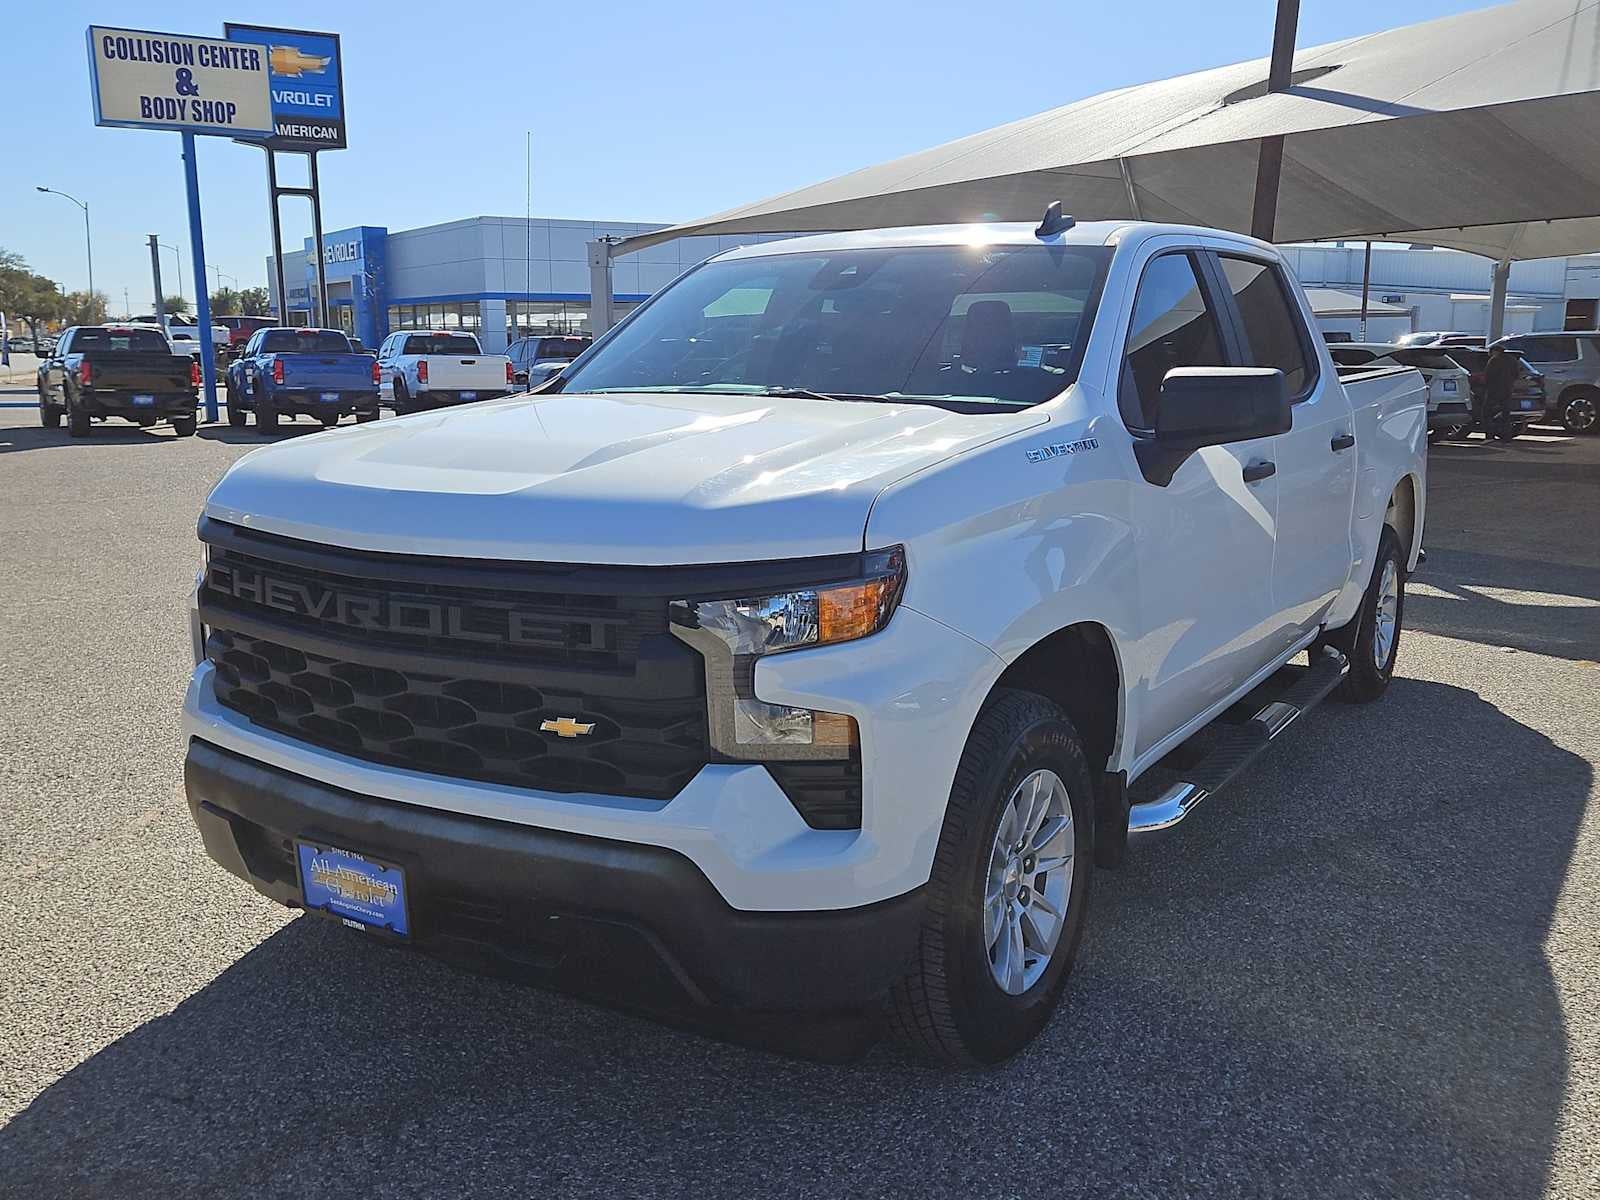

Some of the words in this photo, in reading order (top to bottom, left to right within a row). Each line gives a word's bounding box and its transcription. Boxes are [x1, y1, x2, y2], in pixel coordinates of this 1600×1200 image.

[103, 35, 194, 65] COLLISION
[199, 44, 261, 71] CENTER
[175, 67, 199, 97] &
[140, 96, 187, 121] BODY
[192, 100, 236, 124] SHOP
[207, 563, 629, 649] CHEVROLET
[311, 857, 330, 875] All
[335, 864, 398, 896] American
